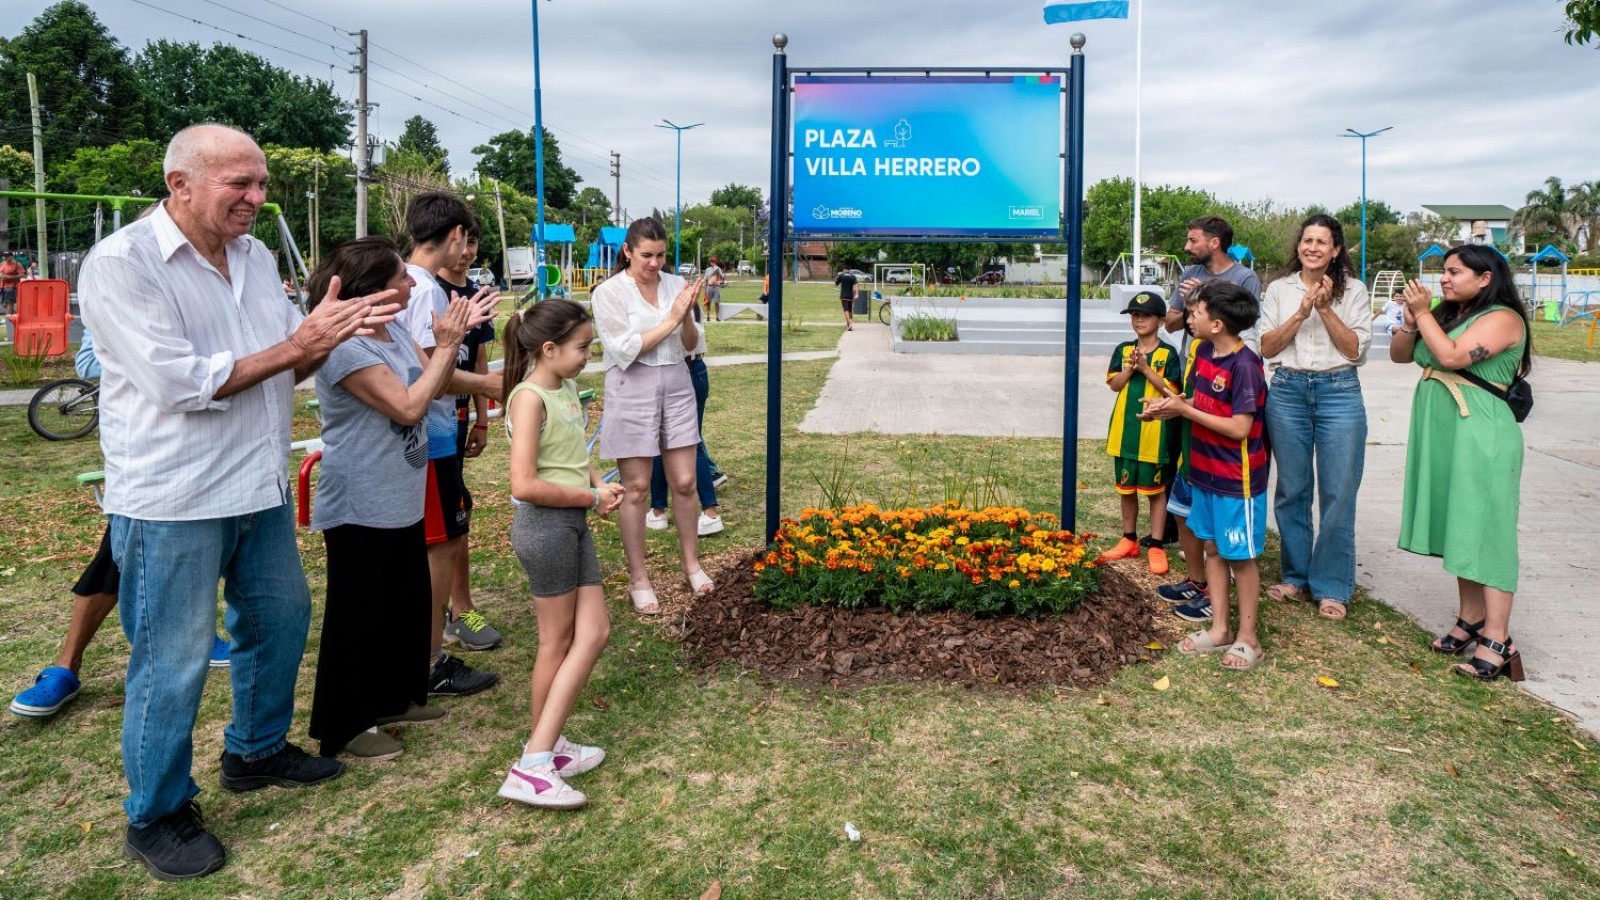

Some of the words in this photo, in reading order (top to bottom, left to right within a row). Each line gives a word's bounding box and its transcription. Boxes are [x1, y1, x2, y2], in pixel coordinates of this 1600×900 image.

[805, 129, 877, 148] PLAZA
[805, 157, 867, 176] VILLA
[875, 157, 980, 177] HERRERO
[830, 209, 863, 217] MORENO
[1012, 208, 1041, 217] MARIEL
[1153, 469, 1162, 485] 4
